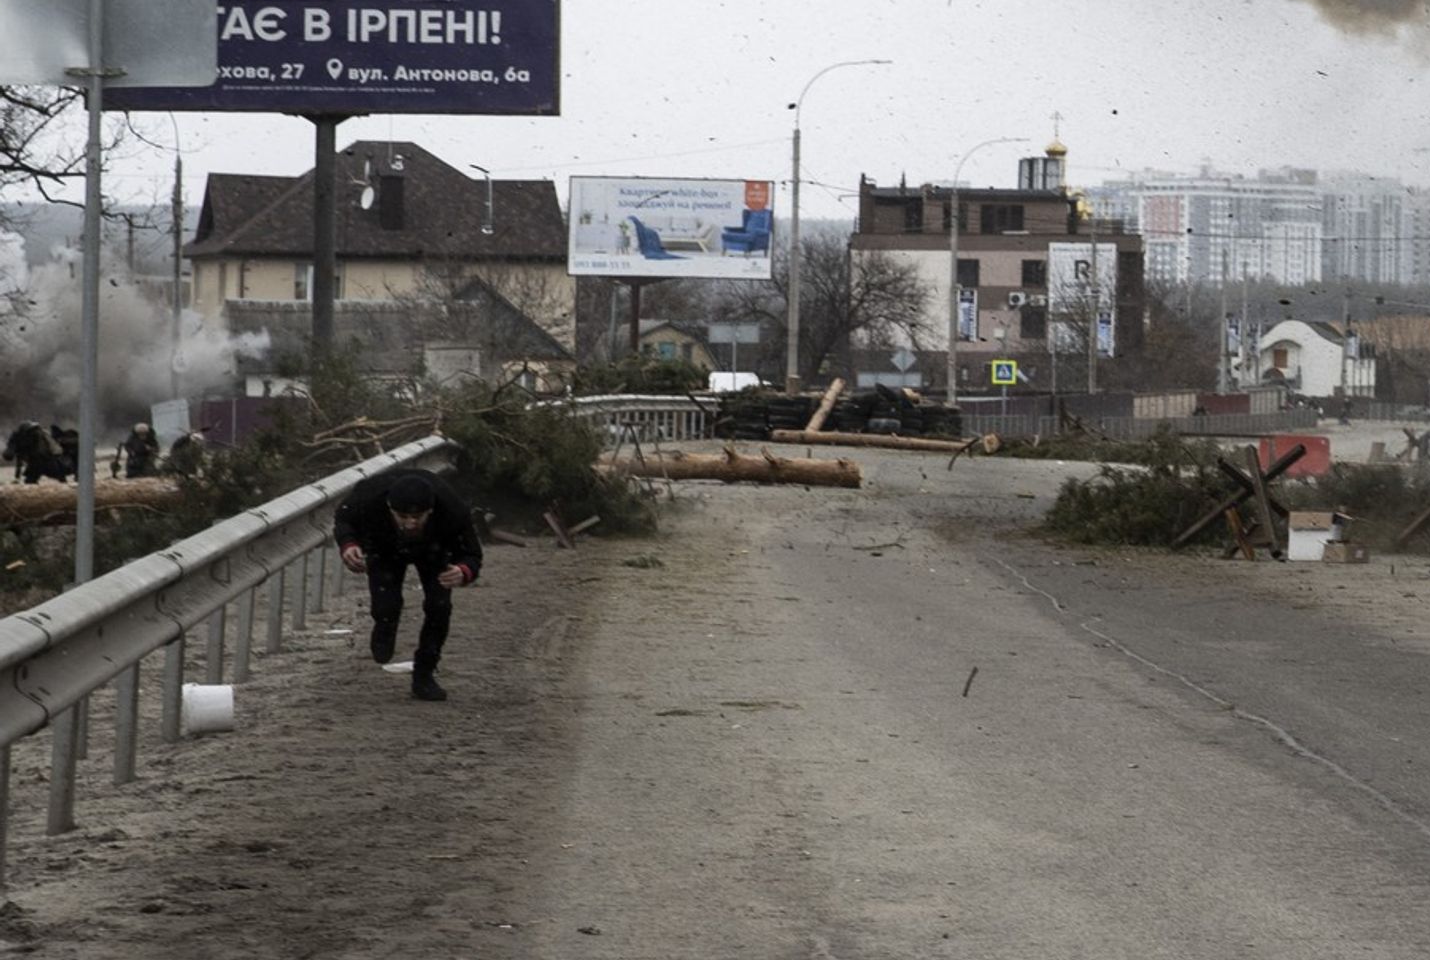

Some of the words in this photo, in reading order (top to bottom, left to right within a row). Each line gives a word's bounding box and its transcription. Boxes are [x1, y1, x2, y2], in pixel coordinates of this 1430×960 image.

[216, 6, 288, 41] АЄ
[304, 7, 332, 42] В
[347, 8, 501, 45] ІРПЕНІ!
[216, 65, 276, 82] хова,
[281, 63, 304, 79] 27
[348, 67, 388, 84] вул.
[394, 65, 499, 84] Антонова,
